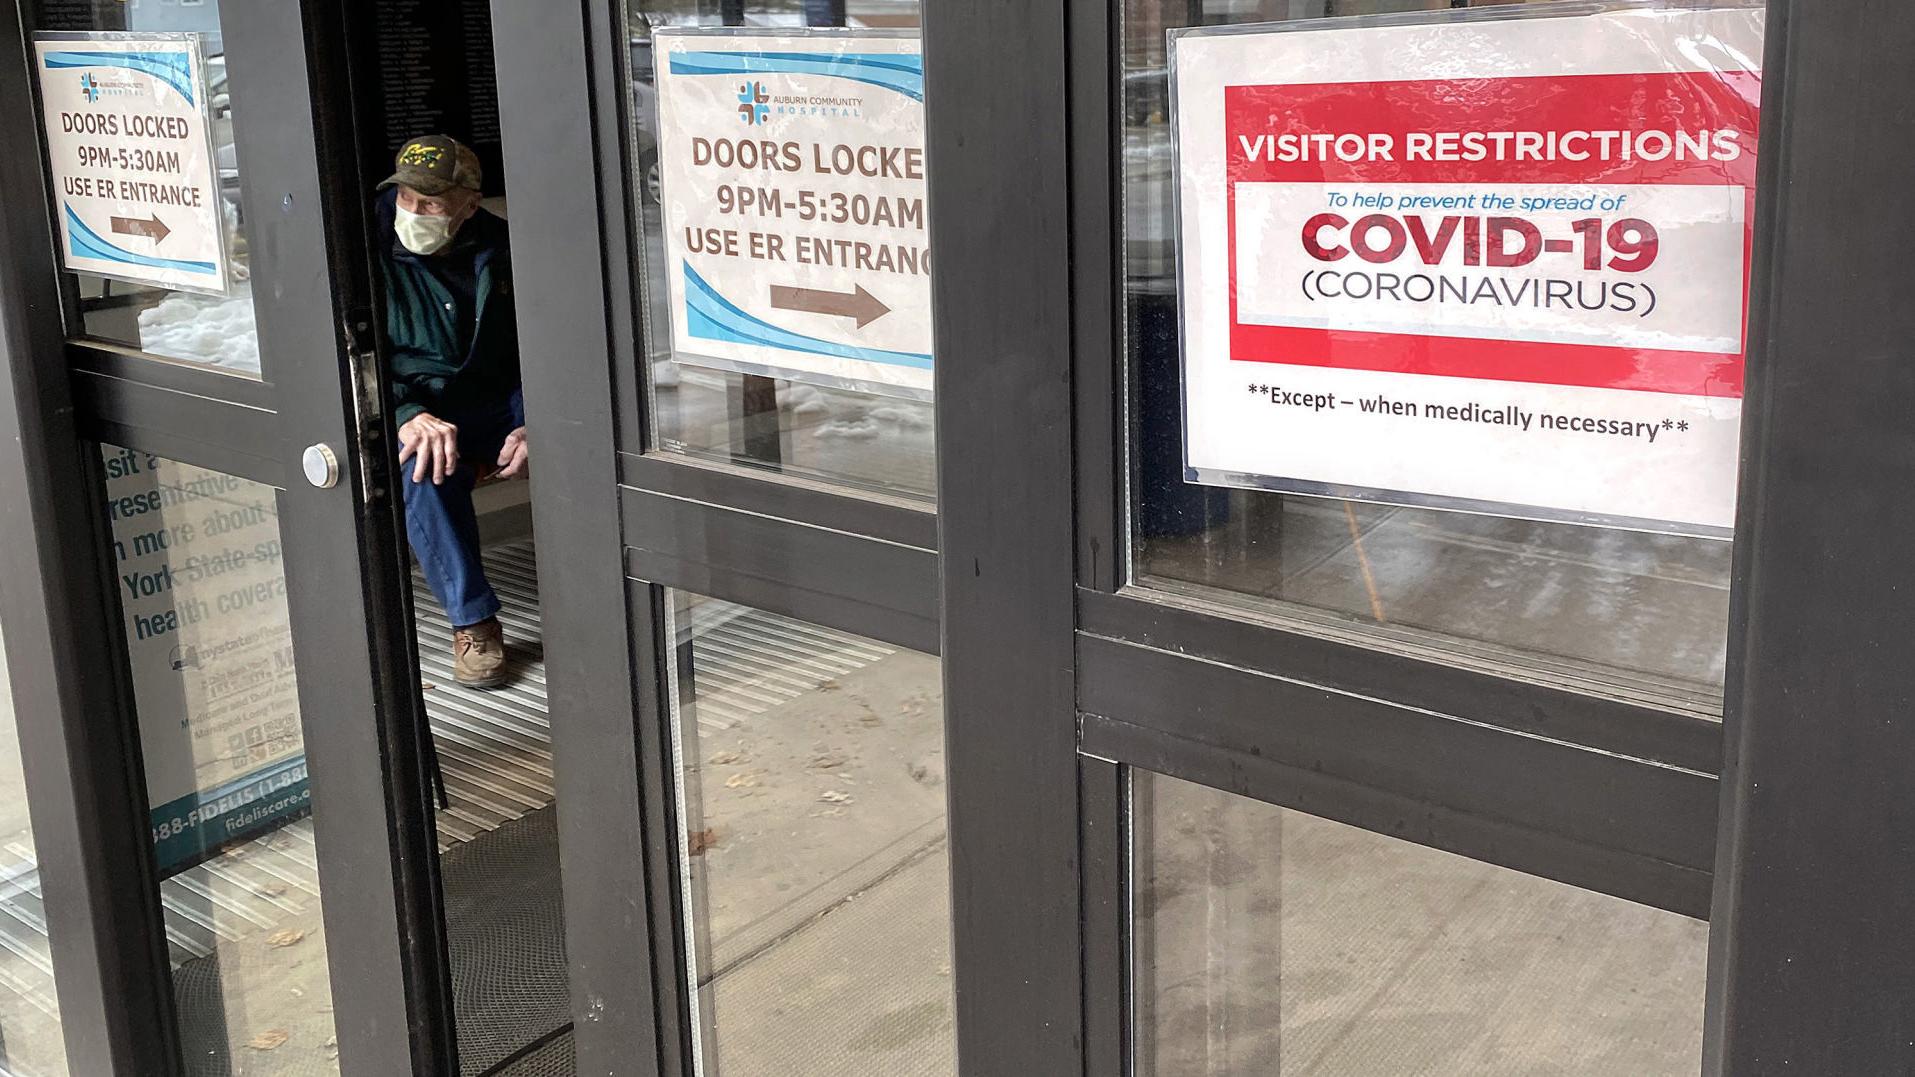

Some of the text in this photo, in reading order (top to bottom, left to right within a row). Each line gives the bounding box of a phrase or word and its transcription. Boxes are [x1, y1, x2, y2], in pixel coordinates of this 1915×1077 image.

[773, 95, 863, 106] AUBURN COMMUNITY
[777, 106, 860, 117] HOSPITAL
[61, 112, 189, 140] DOORS LOCKED
[78, 145, 181, 174] 9PM-5:30AM
[692, 137, 924, 180] DOORS LOCKE
[1238, 129, 1741, 162] VISITOR RESTRICTIONS
[63, 176, 202, 207] USE ER ENTRANCE
[717, 184, 924, 230] 9PM-5:30AM
[1327, 192, 1627, 212] To help prevent the spread of
[685, 226, 739, 257] USE
[749, 232, 786, 261] ER
[1302, 213, 1659, 273] COVID-19
[1302, 270, 1656, 318] (CORONAVIRUS)
[1359, 395, 1418, 418] when
[1425, 403, 1533, 431] medically
[105, 449, 139, 479] sit
[133, 527, 196, 557] more
[203, 498, 268, 537] about
[122, 564, 183, 600] York
[134, 596, 210, 641] health
